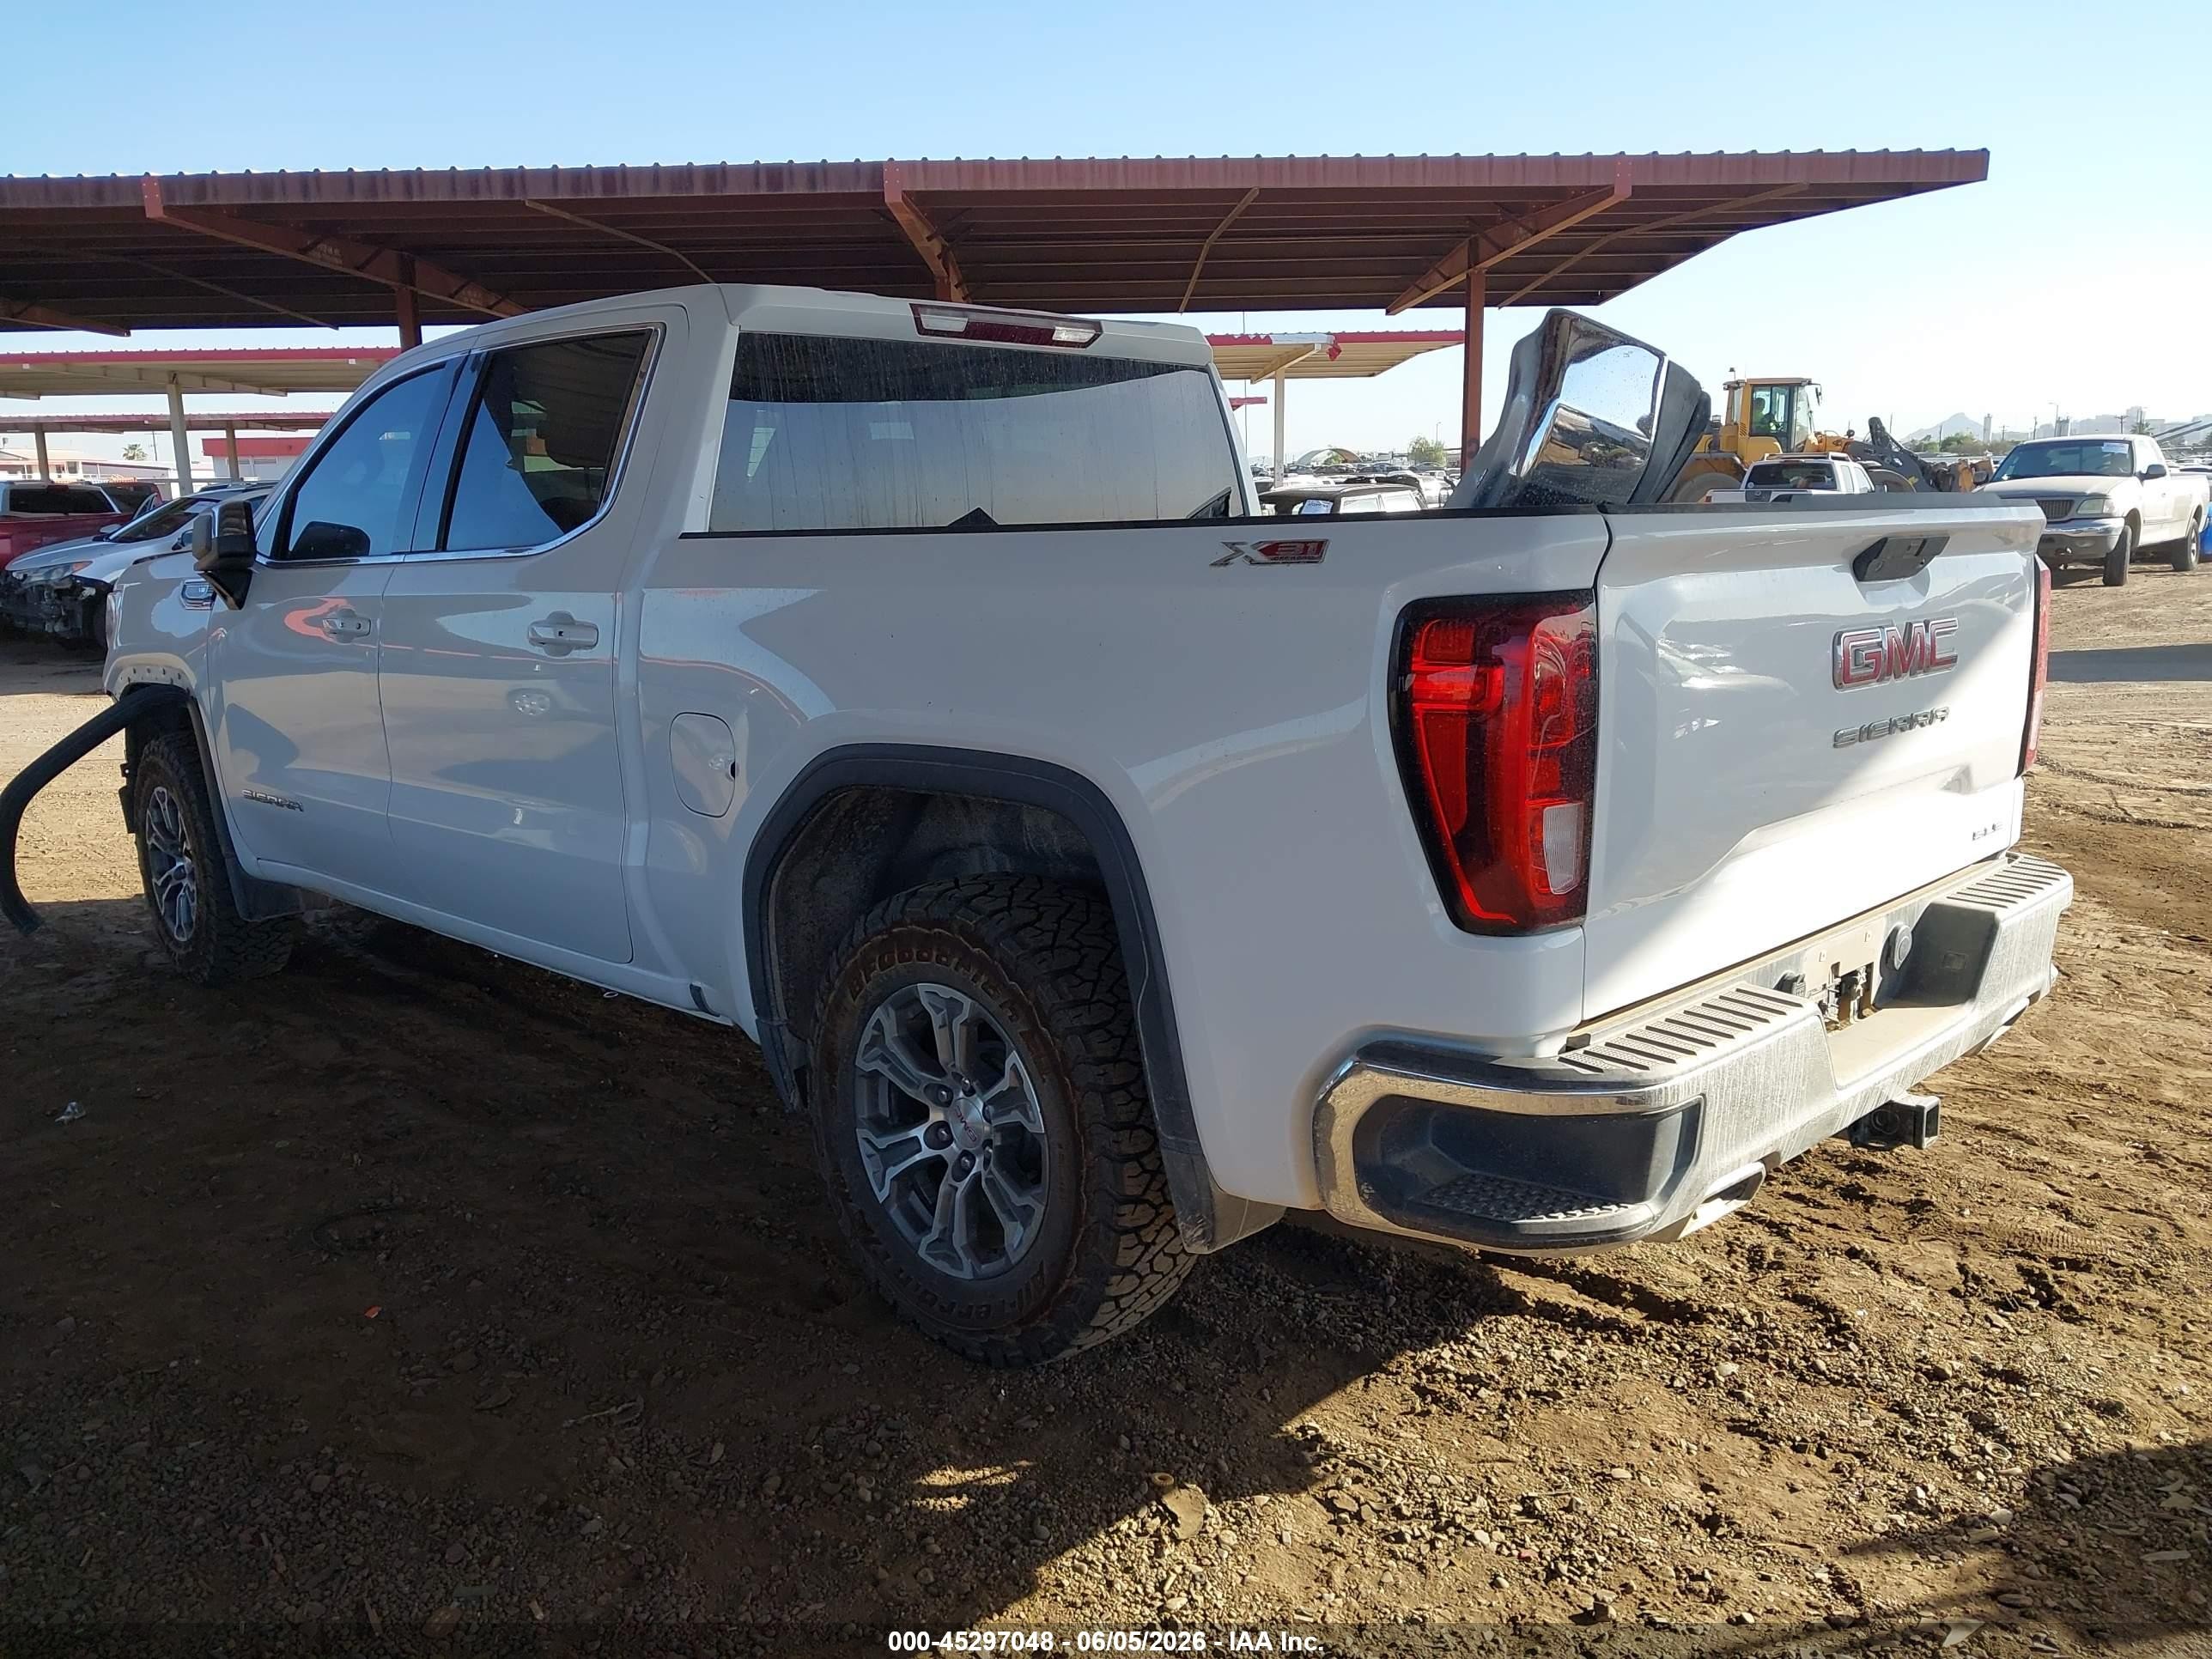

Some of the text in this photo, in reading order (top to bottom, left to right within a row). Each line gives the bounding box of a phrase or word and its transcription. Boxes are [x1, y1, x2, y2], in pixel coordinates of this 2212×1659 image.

[1208, 538, 1330, 567] X31
[1832, 617, 1959, 693] GMC
[1832, 707, 1950, 749] SIERRA
[240, 788, 304, 812] SIERRA
[954, 1105, 977, 1142] GMC
